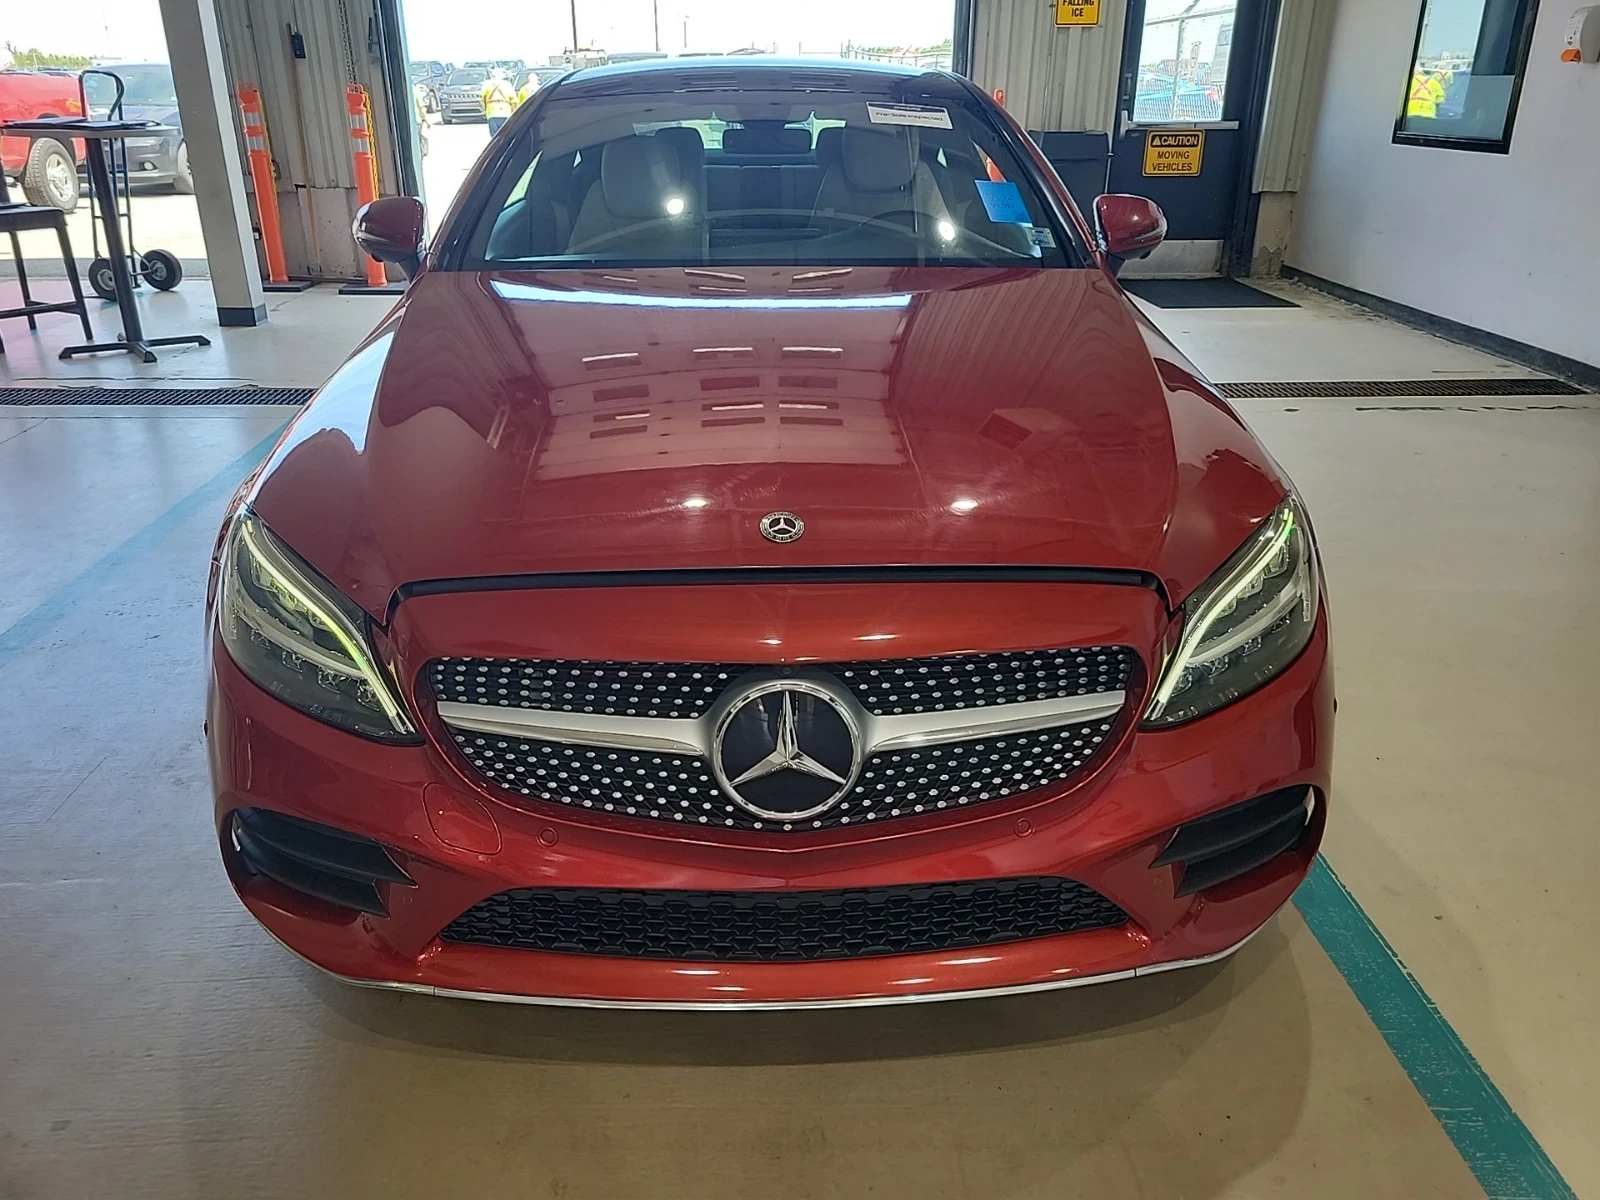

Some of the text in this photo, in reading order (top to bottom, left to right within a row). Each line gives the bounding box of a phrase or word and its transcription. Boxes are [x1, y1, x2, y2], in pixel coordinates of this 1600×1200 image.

[1071, 8, 1085, 17] ICE
[1161, 136, 1198, 146] CAUTION
[1157, 151, 1190, 160] MOVING
[1152, 162, 1193, 172] VEHICLES
